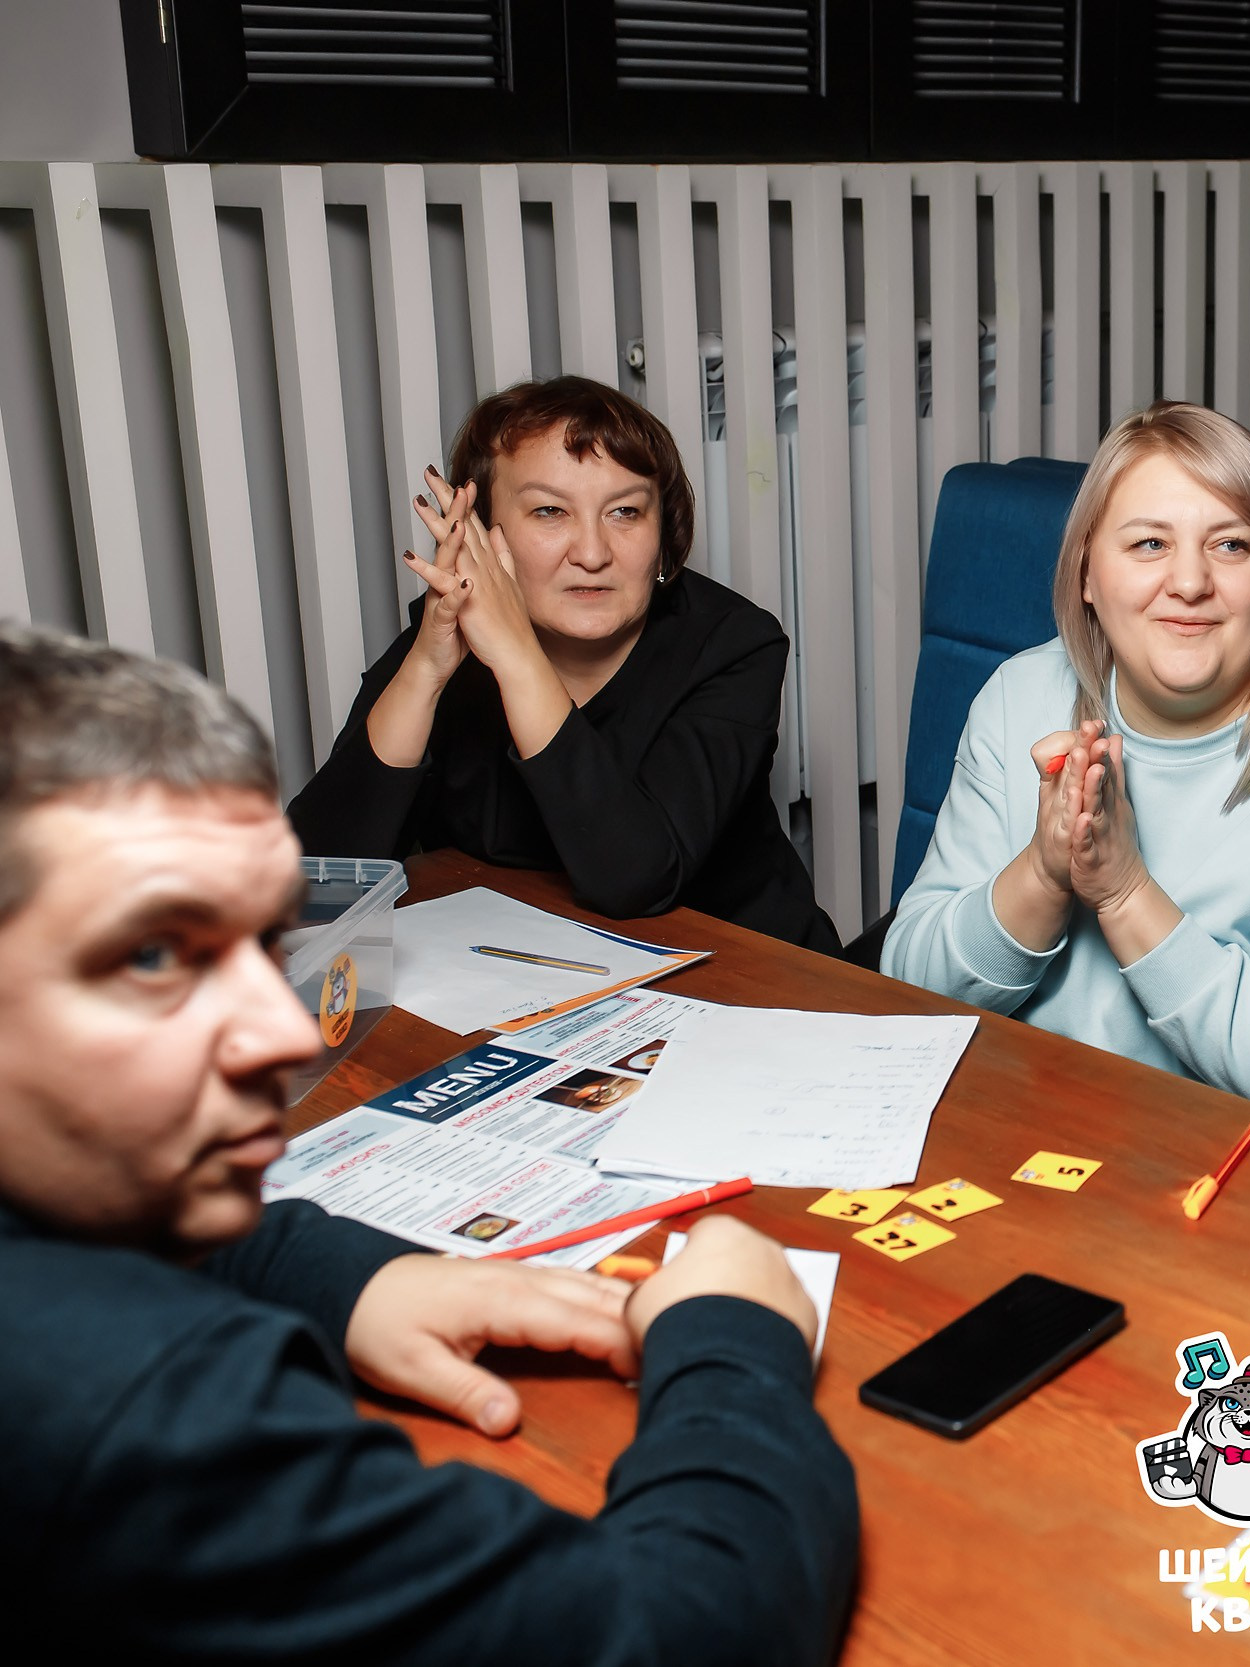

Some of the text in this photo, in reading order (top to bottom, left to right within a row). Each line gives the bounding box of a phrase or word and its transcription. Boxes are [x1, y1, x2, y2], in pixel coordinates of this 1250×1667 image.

[391, 1052, 519, 1114] MENU
[1057, 1167, 1085, 1176] 5
[840, 1203, 868, 1216] 3
